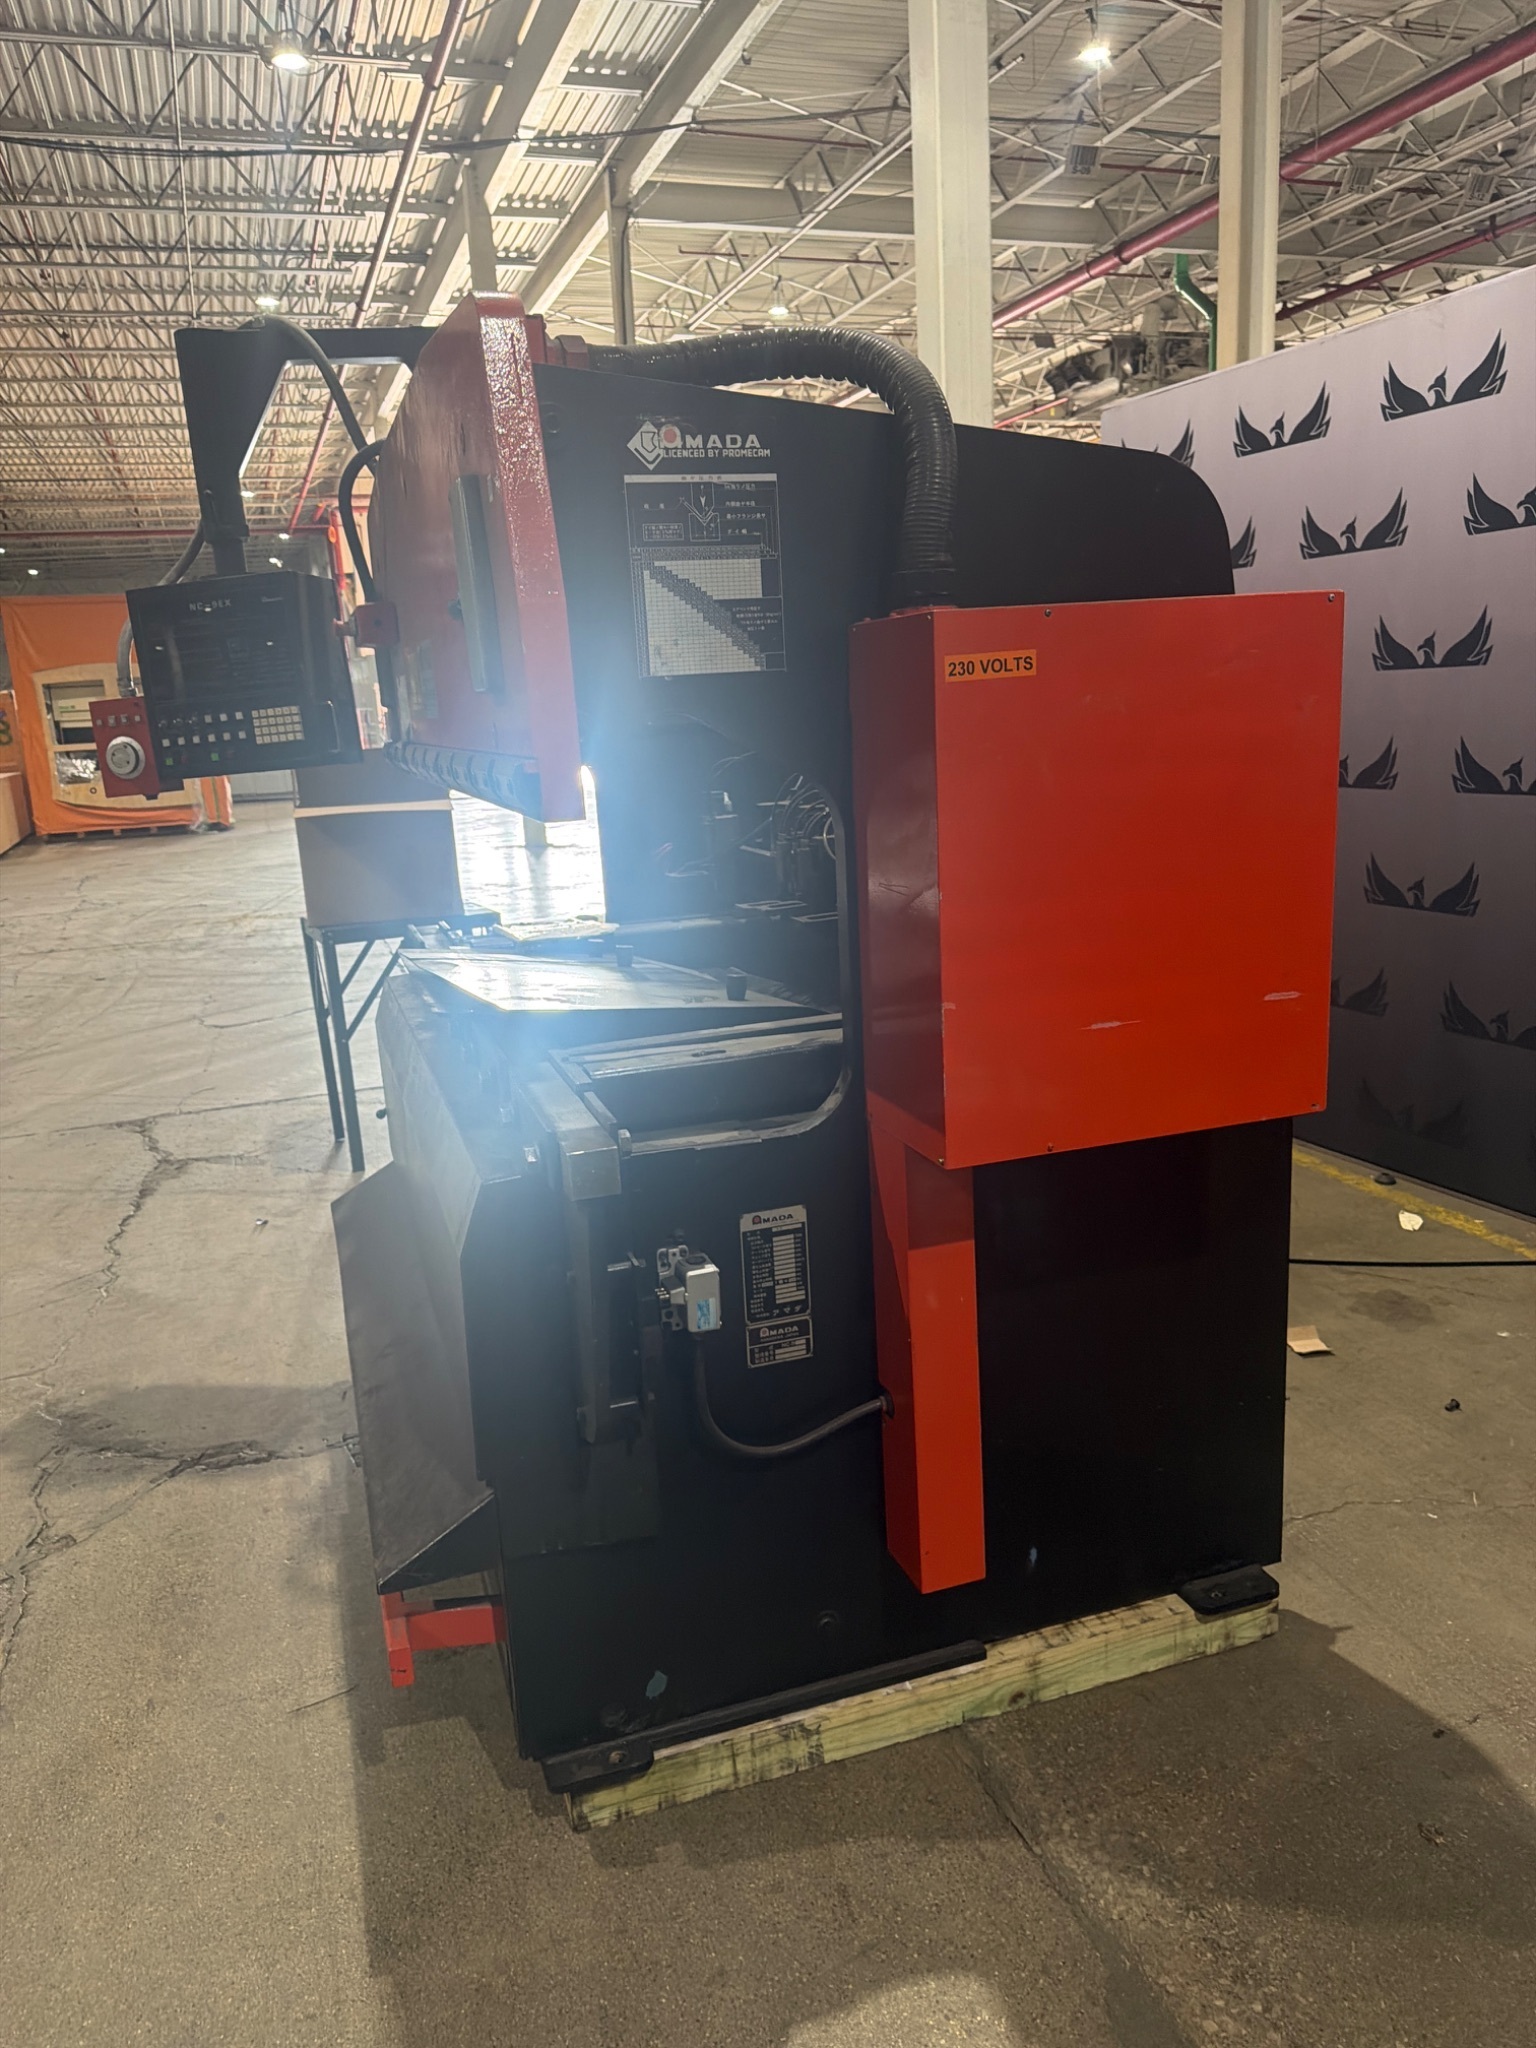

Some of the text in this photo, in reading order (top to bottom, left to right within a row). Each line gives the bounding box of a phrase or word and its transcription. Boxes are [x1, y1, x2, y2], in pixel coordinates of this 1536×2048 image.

[663, 449, 771, 458] LICENCED BY PROMECAM
[948, 656, 1034, 677] 230 VOLTS
